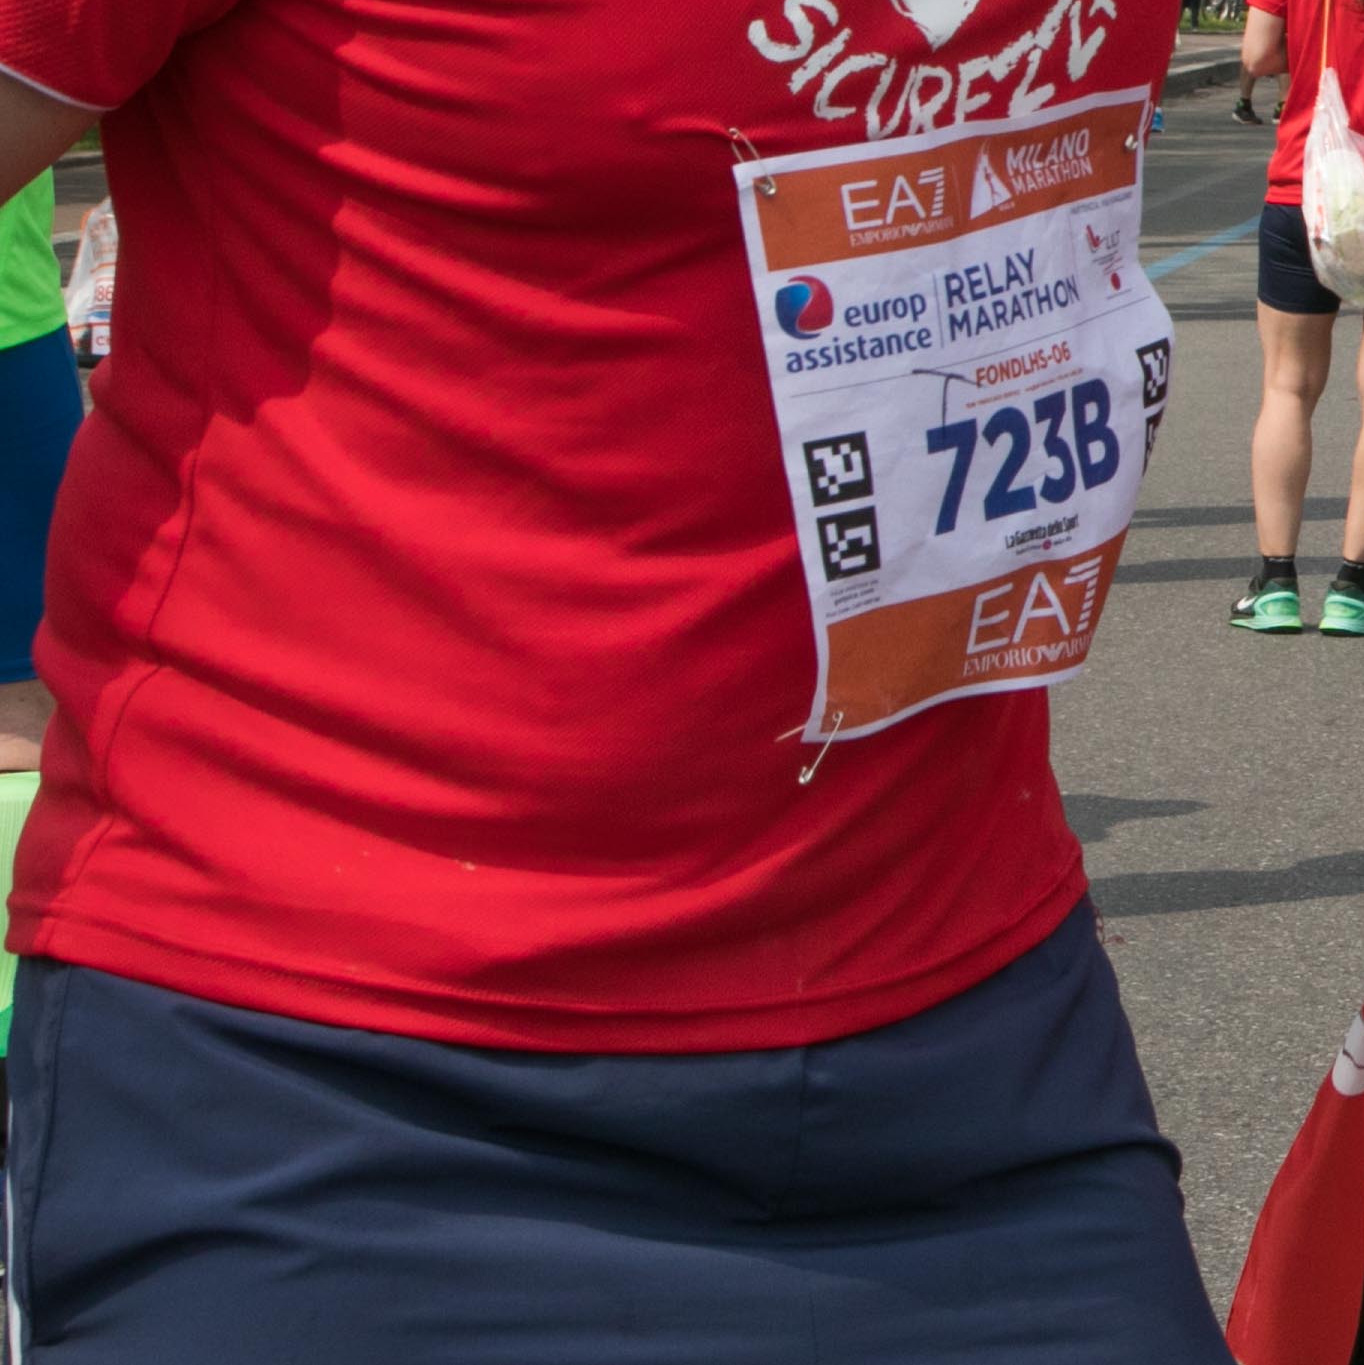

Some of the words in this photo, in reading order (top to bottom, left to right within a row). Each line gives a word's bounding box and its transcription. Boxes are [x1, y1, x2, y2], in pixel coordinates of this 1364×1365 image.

[1006, 128, 1090, 176] MILANO
[841, 167, 944, 230] EA7
[1011, 157, 1093, 196] MARATHON
[943, 248, 1036, 308] RELAY
[844, 293, 927, 328] europ
[948, 275, 1080, 342] MARATHON
[786, 326, 932, 373] assistance
[975, 341, 1072, 387] FONDLHS-06
[926, 378, 1120, 536] 723B
[966, 555, 1102, 655] EA7
[963, 645, 1042, 677] EMPORIO
